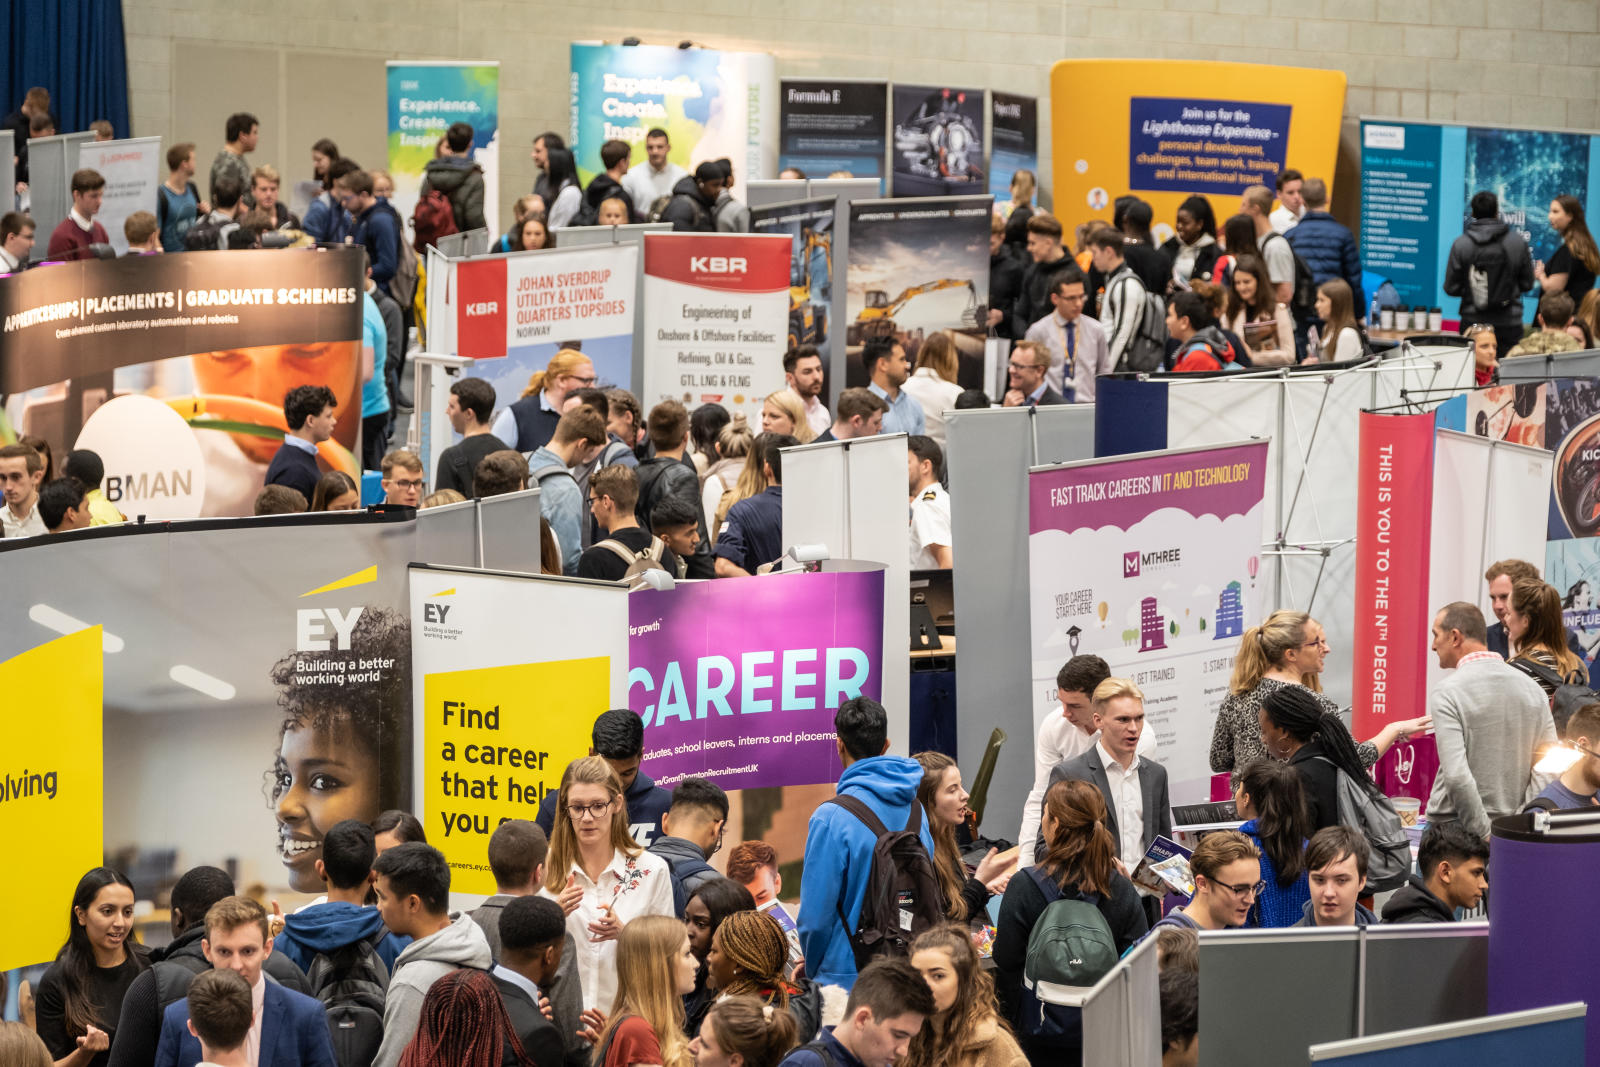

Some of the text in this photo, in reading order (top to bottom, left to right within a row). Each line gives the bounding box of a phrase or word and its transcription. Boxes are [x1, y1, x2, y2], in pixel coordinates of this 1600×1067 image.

[788, 89, 831, 104] Formula
[1182, 107, 1250, 123] Join us for the
[1142, 119, 1272, 141] Lighthouse Experience
[1158, 140, 1203, 154] personal
[1194, 155, 1219, 166] team
[1247, 159, 1279, 174] training
[1155, 168, 1176, 180] and
[1177, 170, 1237, 183] international
[690, 256, 748, 273] KBR
[516, 269, 611, 292] JOHAN SVERDRUP
[86, 291, 174, 315] PLACEMENTS
[186, 288, 273, 307] GRADUATE
[277, 287, 356, 305] SCHEMES
[516, 286, 604, 308] UTILITY & LIVING
[466, 301, 499, 317] KBR
[516, 300, 625, 325] QUARTERS TOPSIDES
[682, 303, 752, 322] Engineering of
[95, 323, 115, 332] custom
[116, 319, 149, 330] laboratory
[150, 316, 191, 327] automation
[192, 314, 206, 325] and
[207, 314, 239, 324] robotics
[516, 325, 551, 338] NORWAY
[658, 328, 690, 341] Onshore
[693, 329, 699, 341] &
[701, 329, 736, 342] Offshore
[715, 352, 726, 364] Oil
[728, 352, 734, 364] &
[700, 374, 718, 387] LNG
[721, 375, 726, 387] &
[728, 375, 751, 388] FLNG
[1379, 444, 1393, 482] THIS
[1582, 449, 1600, 461] KIC
[106, 469, 192, 502] BMAN
[1051, 463, 1251, 508] FAST TRACK CAREERS IN IT AND TECHNOLOGY
[1378, 487, 1391, 502] IS
[1377, 507, 1390, 543] YOU
[1142, 548, 1181, 566] MTHREE
[1376, 548, 1389, 572] TO
[1055, 588, 1093, 607] YOUR CAREER
[1375, 577, 1389, 609] THE
[424, 603, 450, 624] EY
[1055, 601, 1092, 620] STARTS HERE
[296, 607, 366, 652] EY
[296, 658, 395, 674] Building a better
[1209, 657, 1227, 672] START
[296, 671, 380, 687] working world
[1137, 667, 1176, 685] GET TRAINED
[1372, 645, 1387, 714] DEGREE
[629, 647, 870, 730] CAREER
[443, 700, 500, 731] Find
[643, 730, 838, 760] aduates, school leavers, interns and placeme
[441, 742, 548, 771] a career
[441, 770, 498, 801] that
[441, 811, 489, 837] you
[448, 862, 493, 871] careers.ey.co
